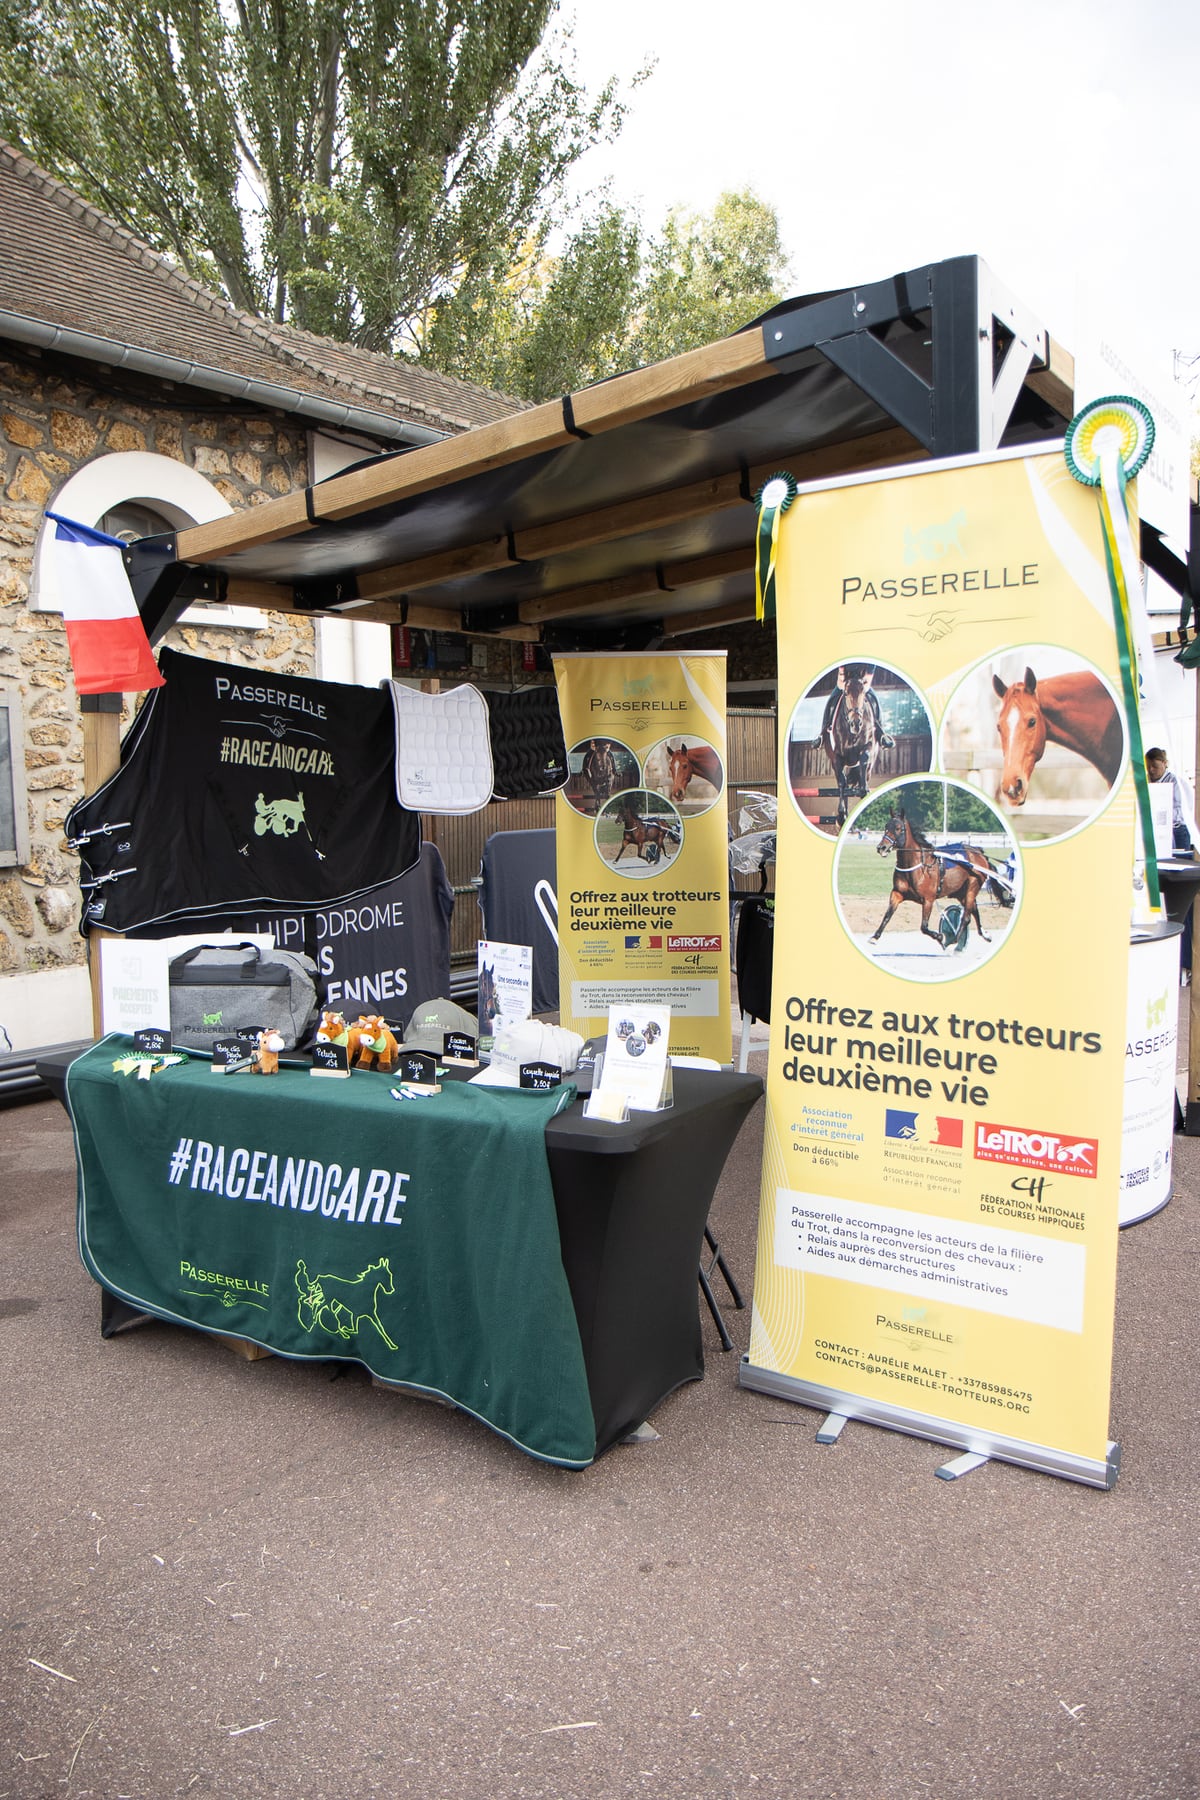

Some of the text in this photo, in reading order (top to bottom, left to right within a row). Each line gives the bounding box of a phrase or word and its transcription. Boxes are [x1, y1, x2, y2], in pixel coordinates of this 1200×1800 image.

[841, 563, 1040, 606] PASSERELLE
[215, 677, 328, 721] PASSERELLE
[589, 698, 688, 712] PASSERELLE
[569, 890, 721, 904] Offrez aux trotteurs
[570, 904, 677, 917] leur meilleure
[570, 917, 674, 931] deuxième vie
[784, 996, 1102, 1054] Offrez aux trotteurs
[784, 1025, 999, 1075] leur meilleure
[782, 1056, 990, 1106] deuxième vie
[801, 1105, 853, 1120] Association
[806, 1117, 848, 1130] reconnue
[792, 1143, 860, 1161] Don déductible
[831, 1128, 864, 1143] général
[977, 1125, 1060, 1159] LeTROT
[819, 1156, 839, 1169] 66%
[168, 1137, 412, 1226] #RACEANDCARE
[979, 1203, 1086, 1232] DES COURSES HIPPIQUES
[980, 1193, 1086, 1221] FÉDÉRATION NATIONALE
[791, 1206, 1044, 1265] Passerelle accompagne les acteurs de la filière
[791, 1218, 1016, 1273] du Trot, dans la reconversion des chevaux
[807, 1233, 956, 1272] Relais auprès des structures
[179, 1260, 270, 1297] PASSERELLE
[806, 1245, 1009, 1297] Aides aux démarches administratives
[875, 1314, 954, 1344] PASSERELLE
[814, 1338, 860, 1357] CONTACT
[867, 1350, 911, 1370] AURÉLIE
[912, 1362, 947, 1379] MALET
[814, 1350, 1031, 1414] CONTACTS@PASSERELLE-TROTTEURS.ORG
